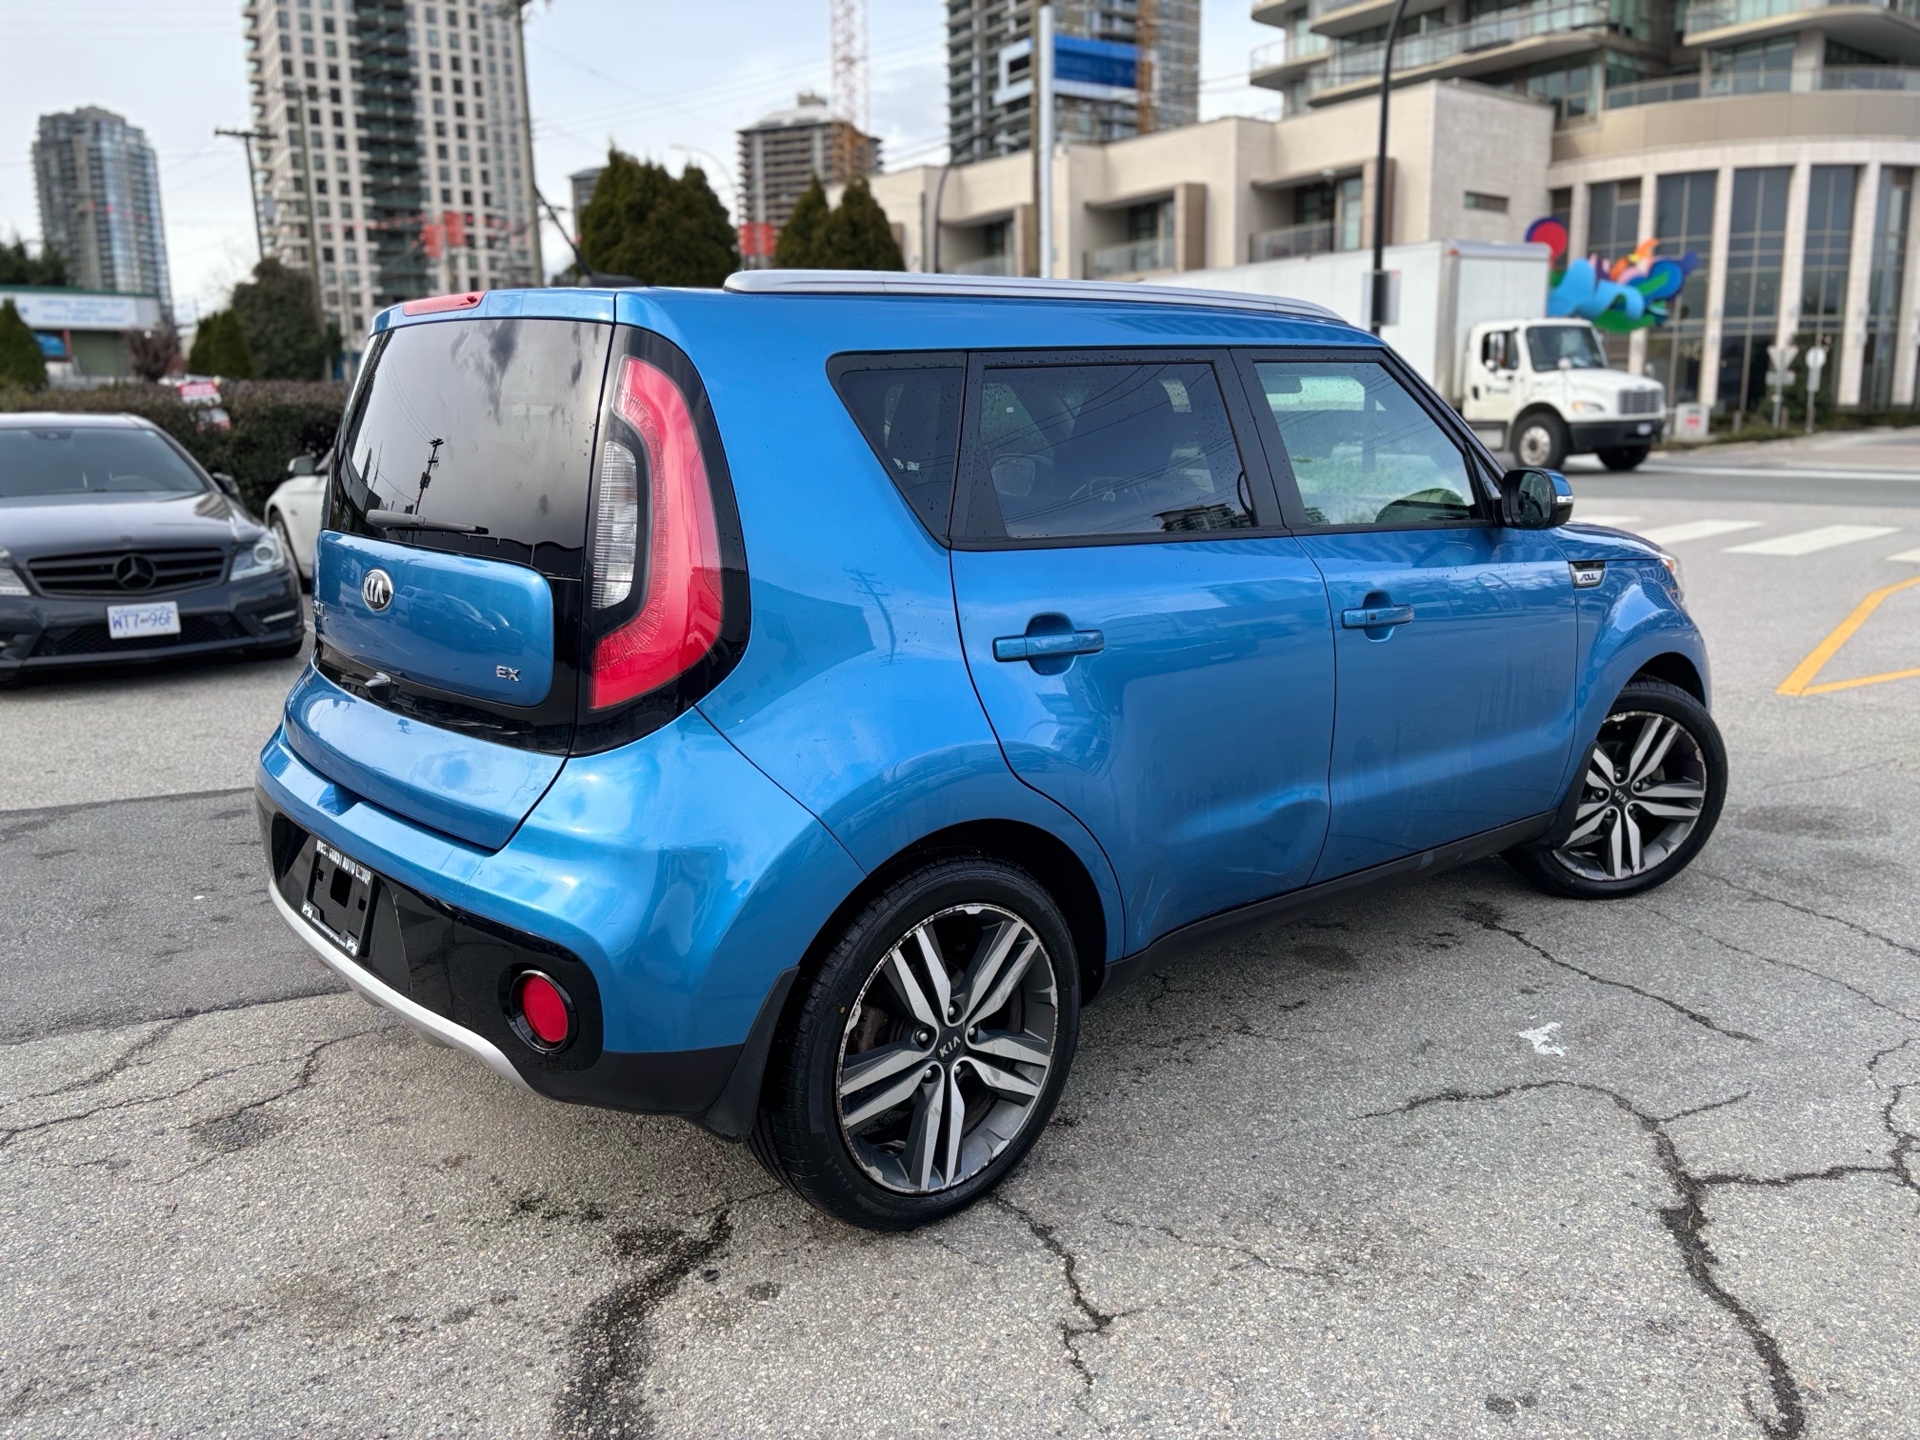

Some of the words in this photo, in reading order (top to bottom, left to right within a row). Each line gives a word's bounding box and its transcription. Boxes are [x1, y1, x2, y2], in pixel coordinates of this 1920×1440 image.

[363, 575, 386, 604] KIA
[495, 665, 520, 682] EX
[1613, 788, 1629, 804] KIA
[939, 1035, 961, 1058] KIA
